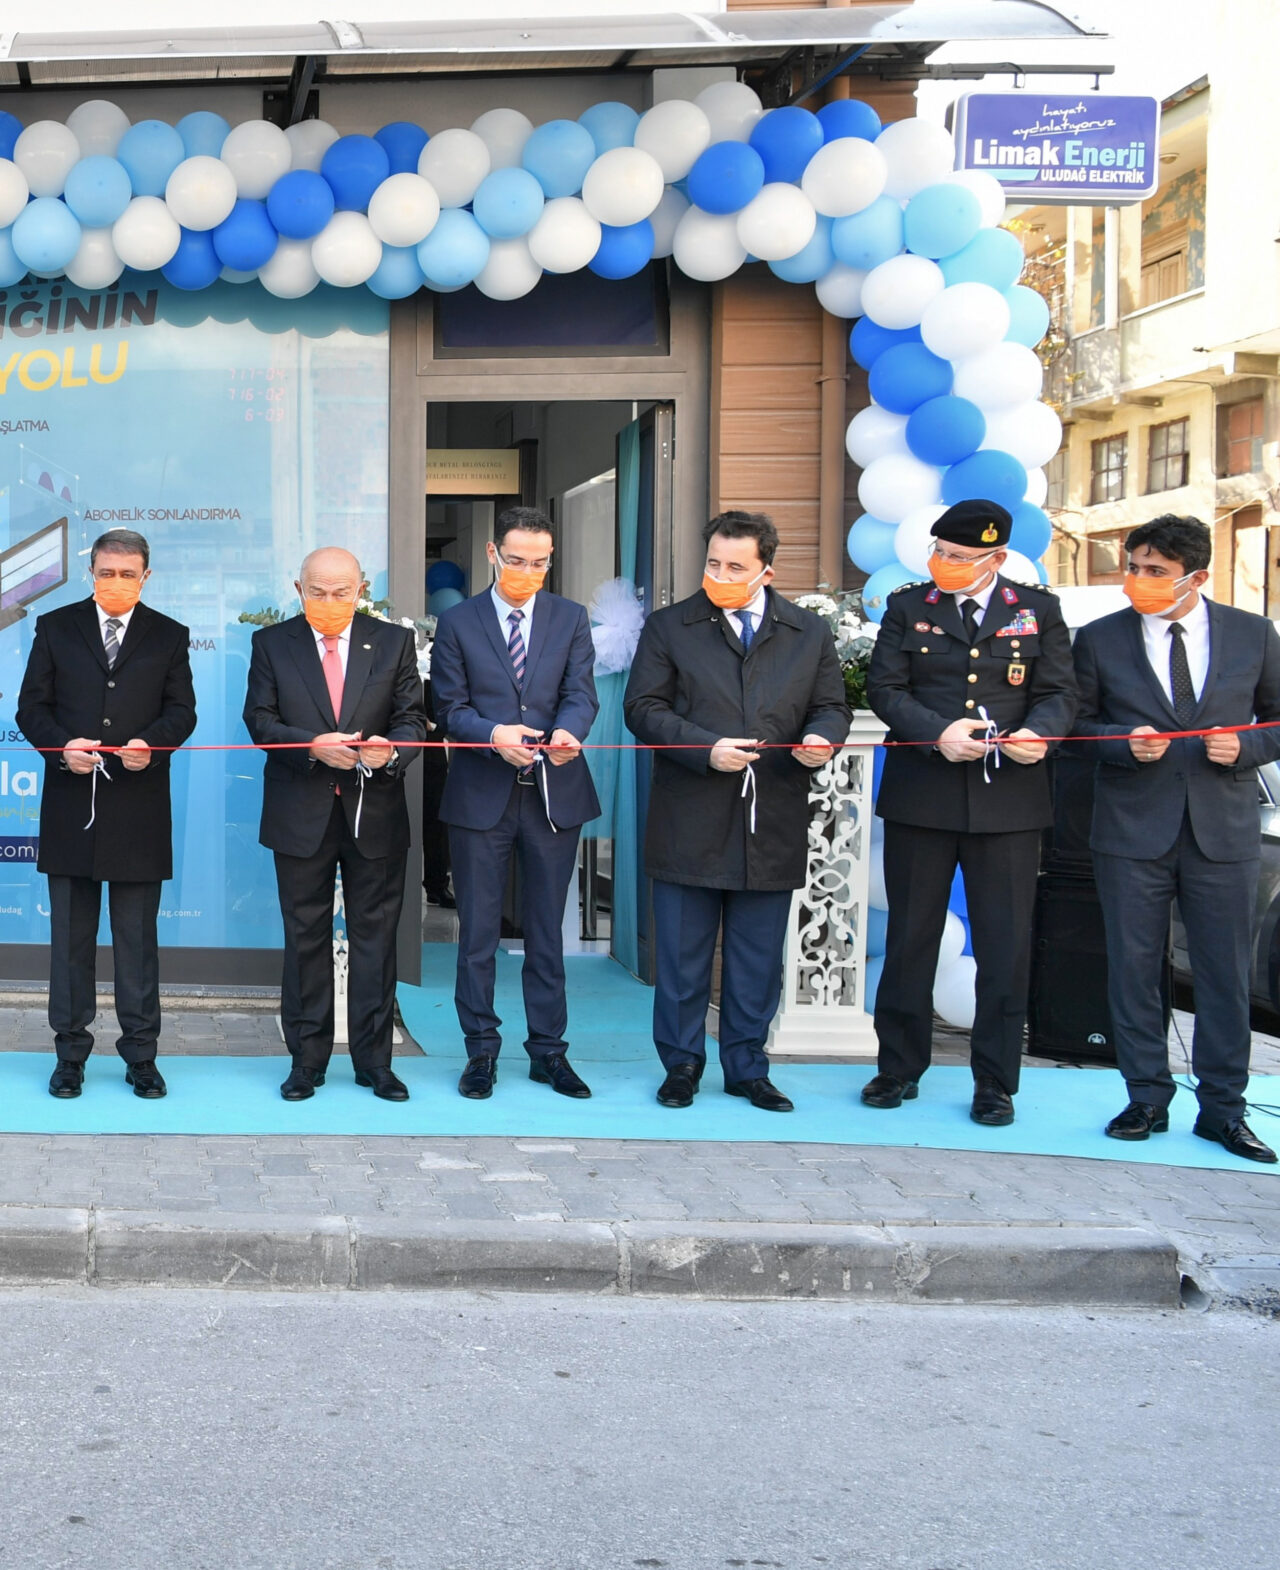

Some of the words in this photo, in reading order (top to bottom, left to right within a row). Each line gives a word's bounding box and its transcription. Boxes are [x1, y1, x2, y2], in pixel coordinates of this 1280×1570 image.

[1042, 102, 1087, 121] hayatı
[1012, 118, 1117, 141] aydınlatıyoruz
[973, 138, 1060, 166] Limak
[1064, 139, 1145, 169] Enerji
[1040, 167, 1087, 182] ULUDAĞ
[1089, 167, 1145, 184] ELEKTRİK
[84, 506, 146, 521] ABONELİK
[147, 508, 241, 521] SONLANDIRMA
[8, 730, 28, 742] SO
